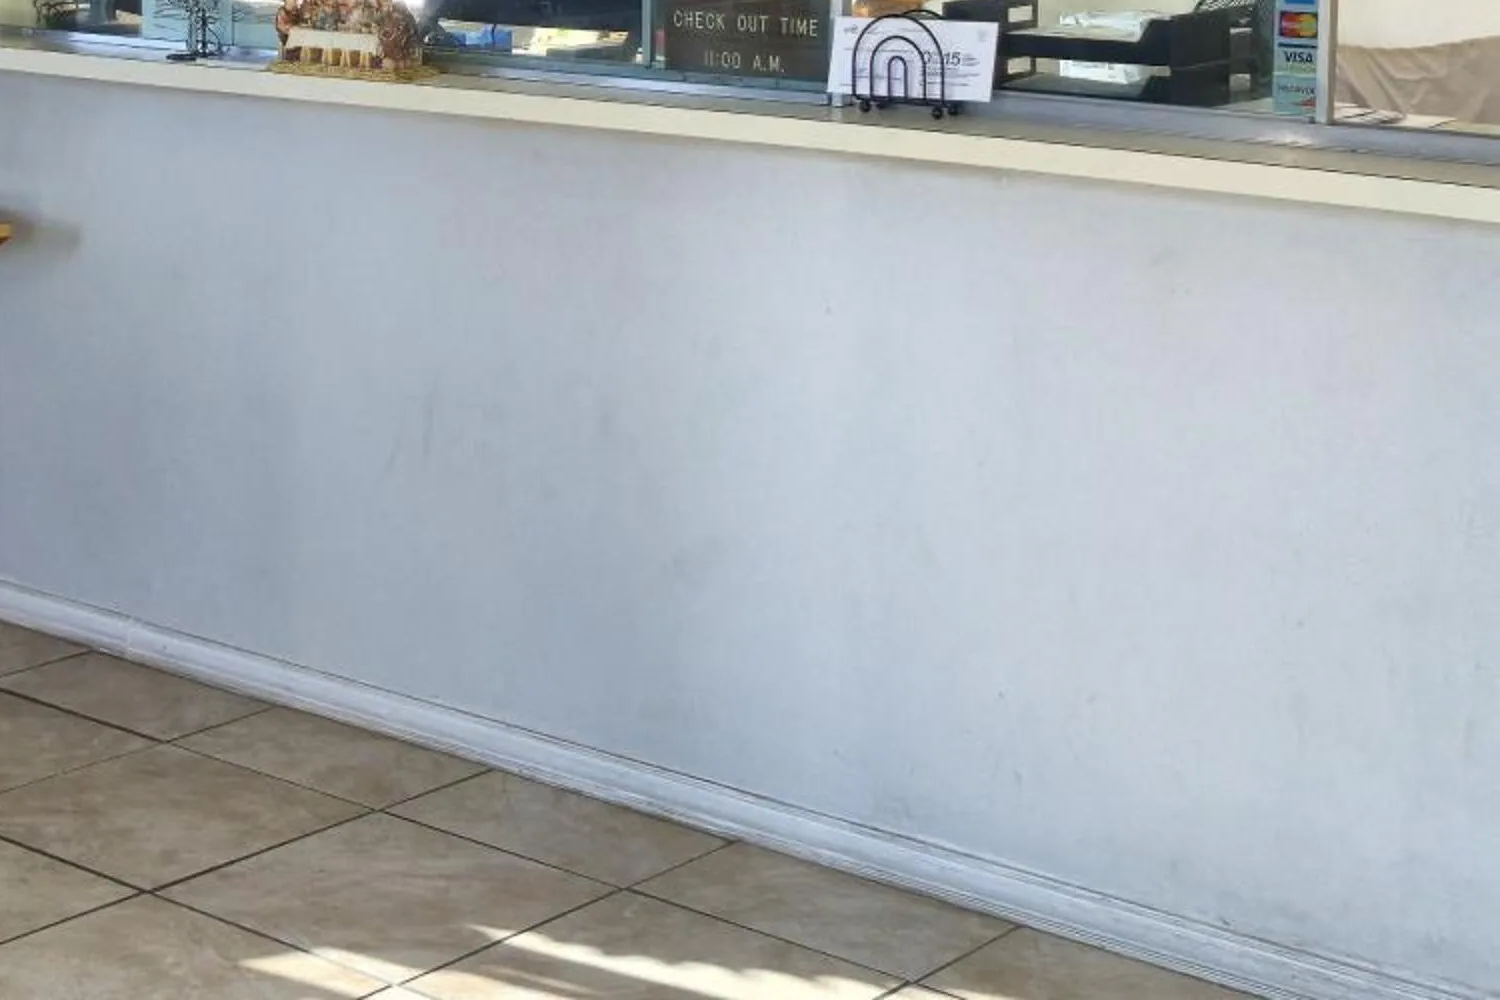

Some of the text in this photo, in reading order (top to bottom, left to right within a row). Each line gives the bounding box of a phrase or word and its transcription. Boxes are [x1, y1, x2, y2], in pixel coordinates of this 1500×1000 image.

[672, 10, 819, 37] CHECK OUT TIME
[703, 51, 786, 74] 11:00 A.M.
[1284, 51, 1313, 64] VISA
